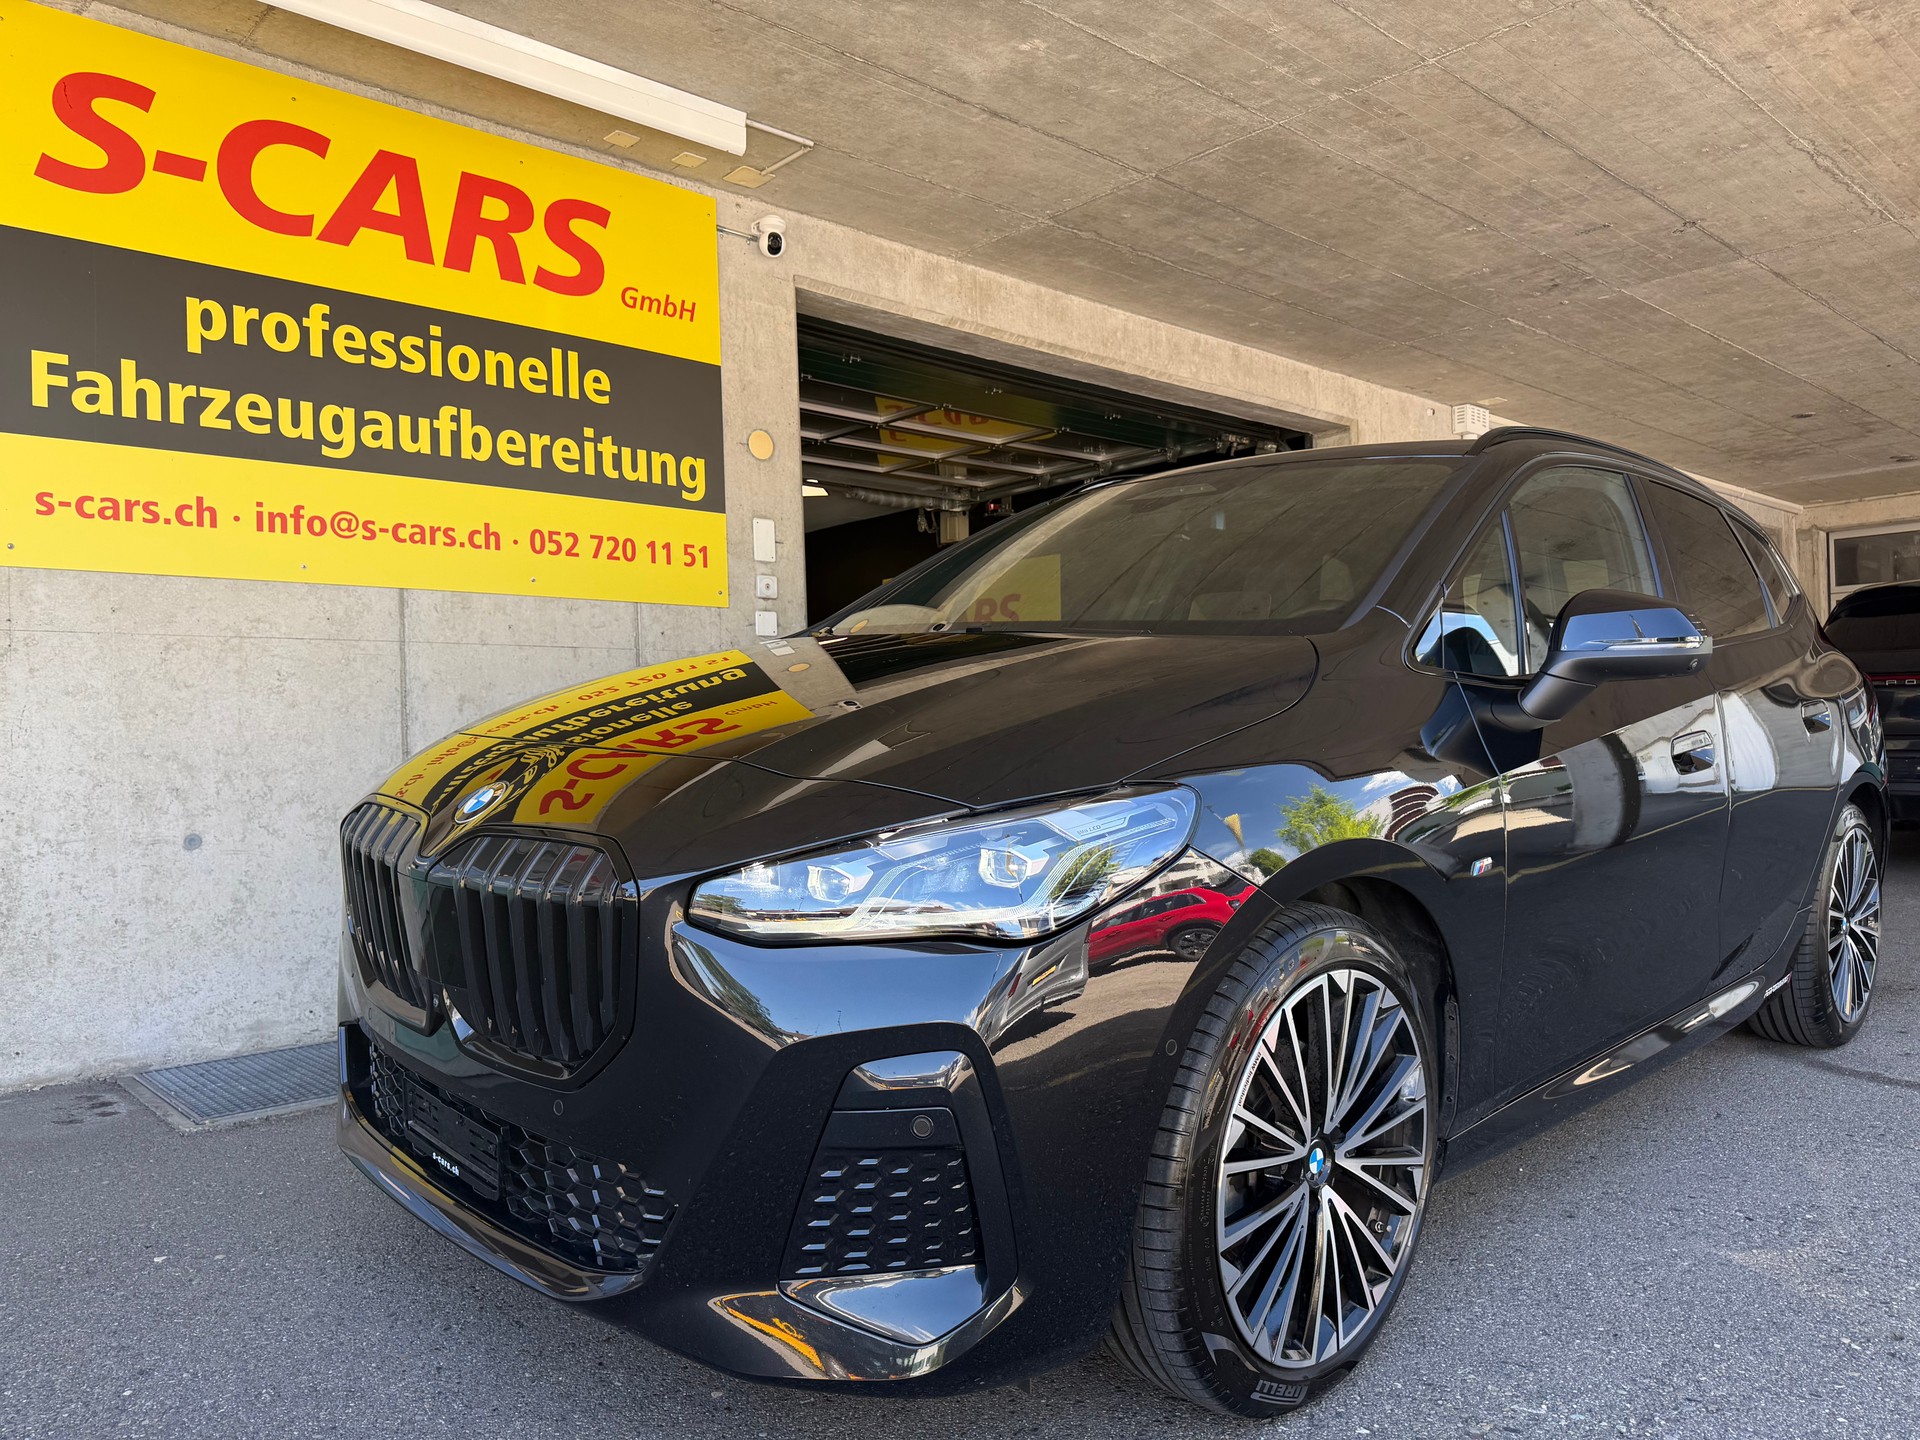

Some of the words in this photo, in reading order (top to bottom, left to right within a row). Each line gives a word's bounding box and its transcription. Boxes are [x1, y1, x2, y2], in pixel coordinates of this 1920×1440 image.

[33, 71, 611, 297] S-CARS
[621, 287, 696, 323] GmbH
[186, 296, 611, 405] professionelle
[30, 350, 706, 502] Fahrzeugaufbereitung
[35, 491, 218, 529] s-cars.ch
[256, 502, 501, 551] info@s-cars.ch
[530, 528, 580, 558] 052
[590, 534, 637, 563] 720
[646, 541, 673, 566] 11
[683, 543, 709, 569] 51
[1250, 1379, 1309, 1406] PIRELLI
